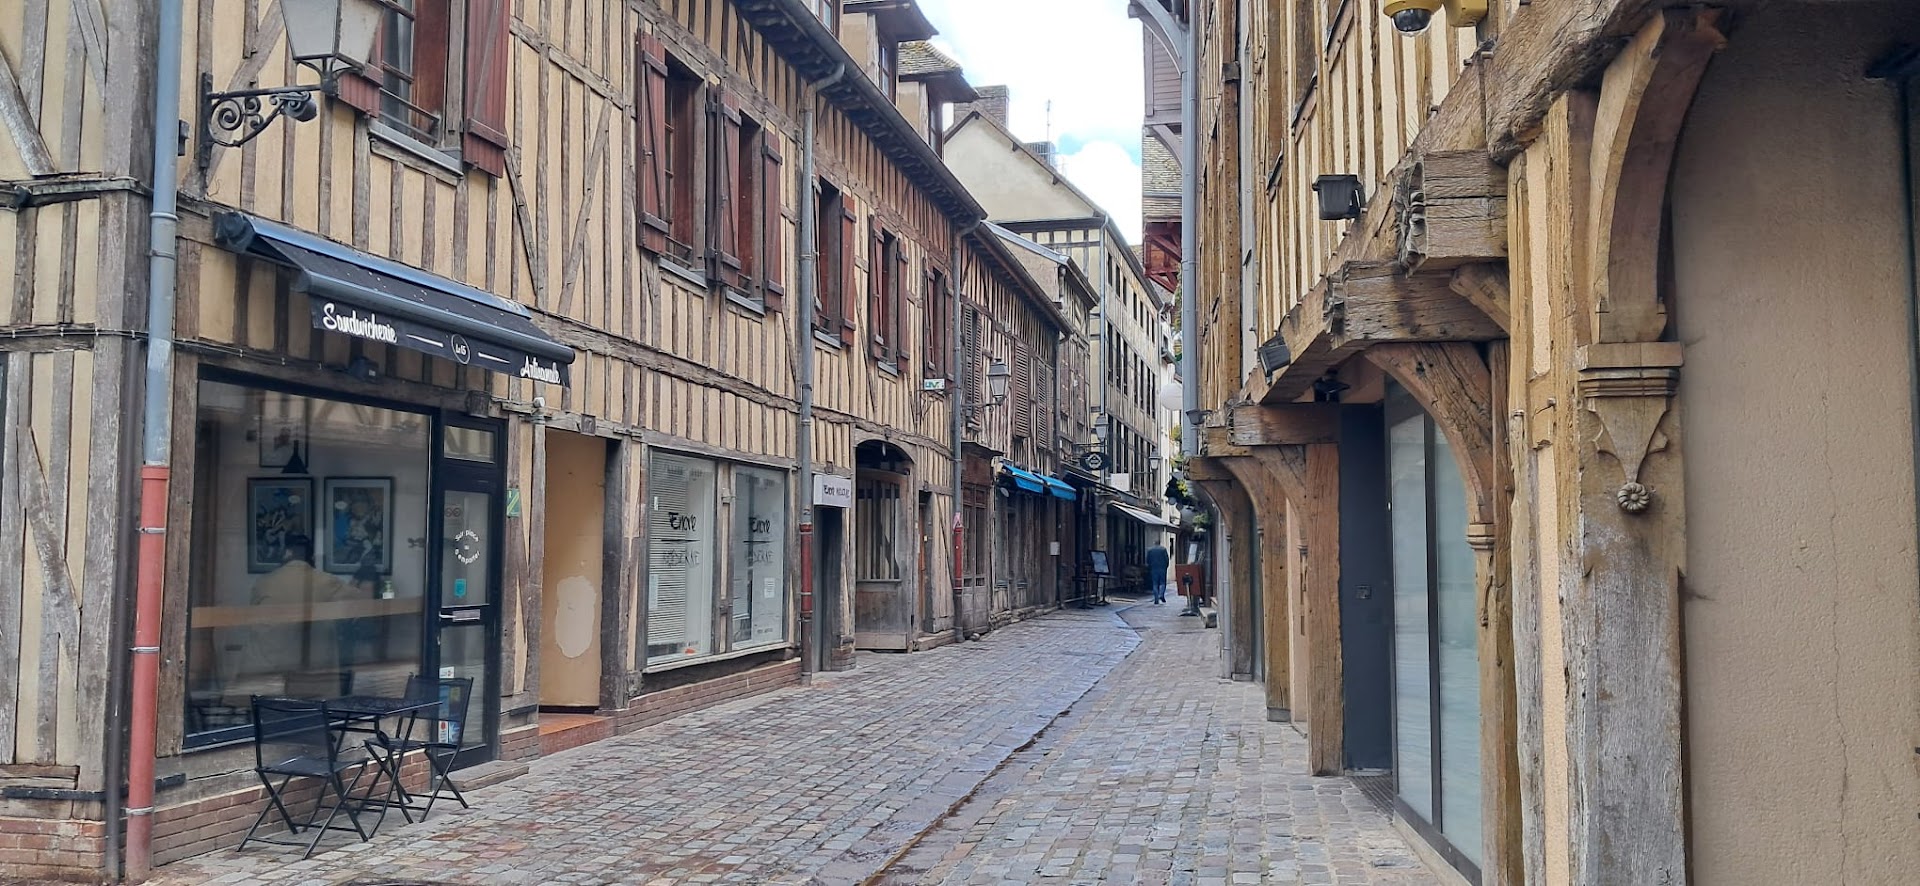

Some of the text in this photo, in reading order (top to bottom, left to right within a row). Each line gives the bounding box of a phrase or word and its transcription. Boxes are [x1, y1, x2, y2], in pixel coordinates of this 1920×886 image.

[322, 302, 398, 343] Sandwicherie
[520, 355, 561, 384] Artisanale
[457, 550, 480, 565] emporter
